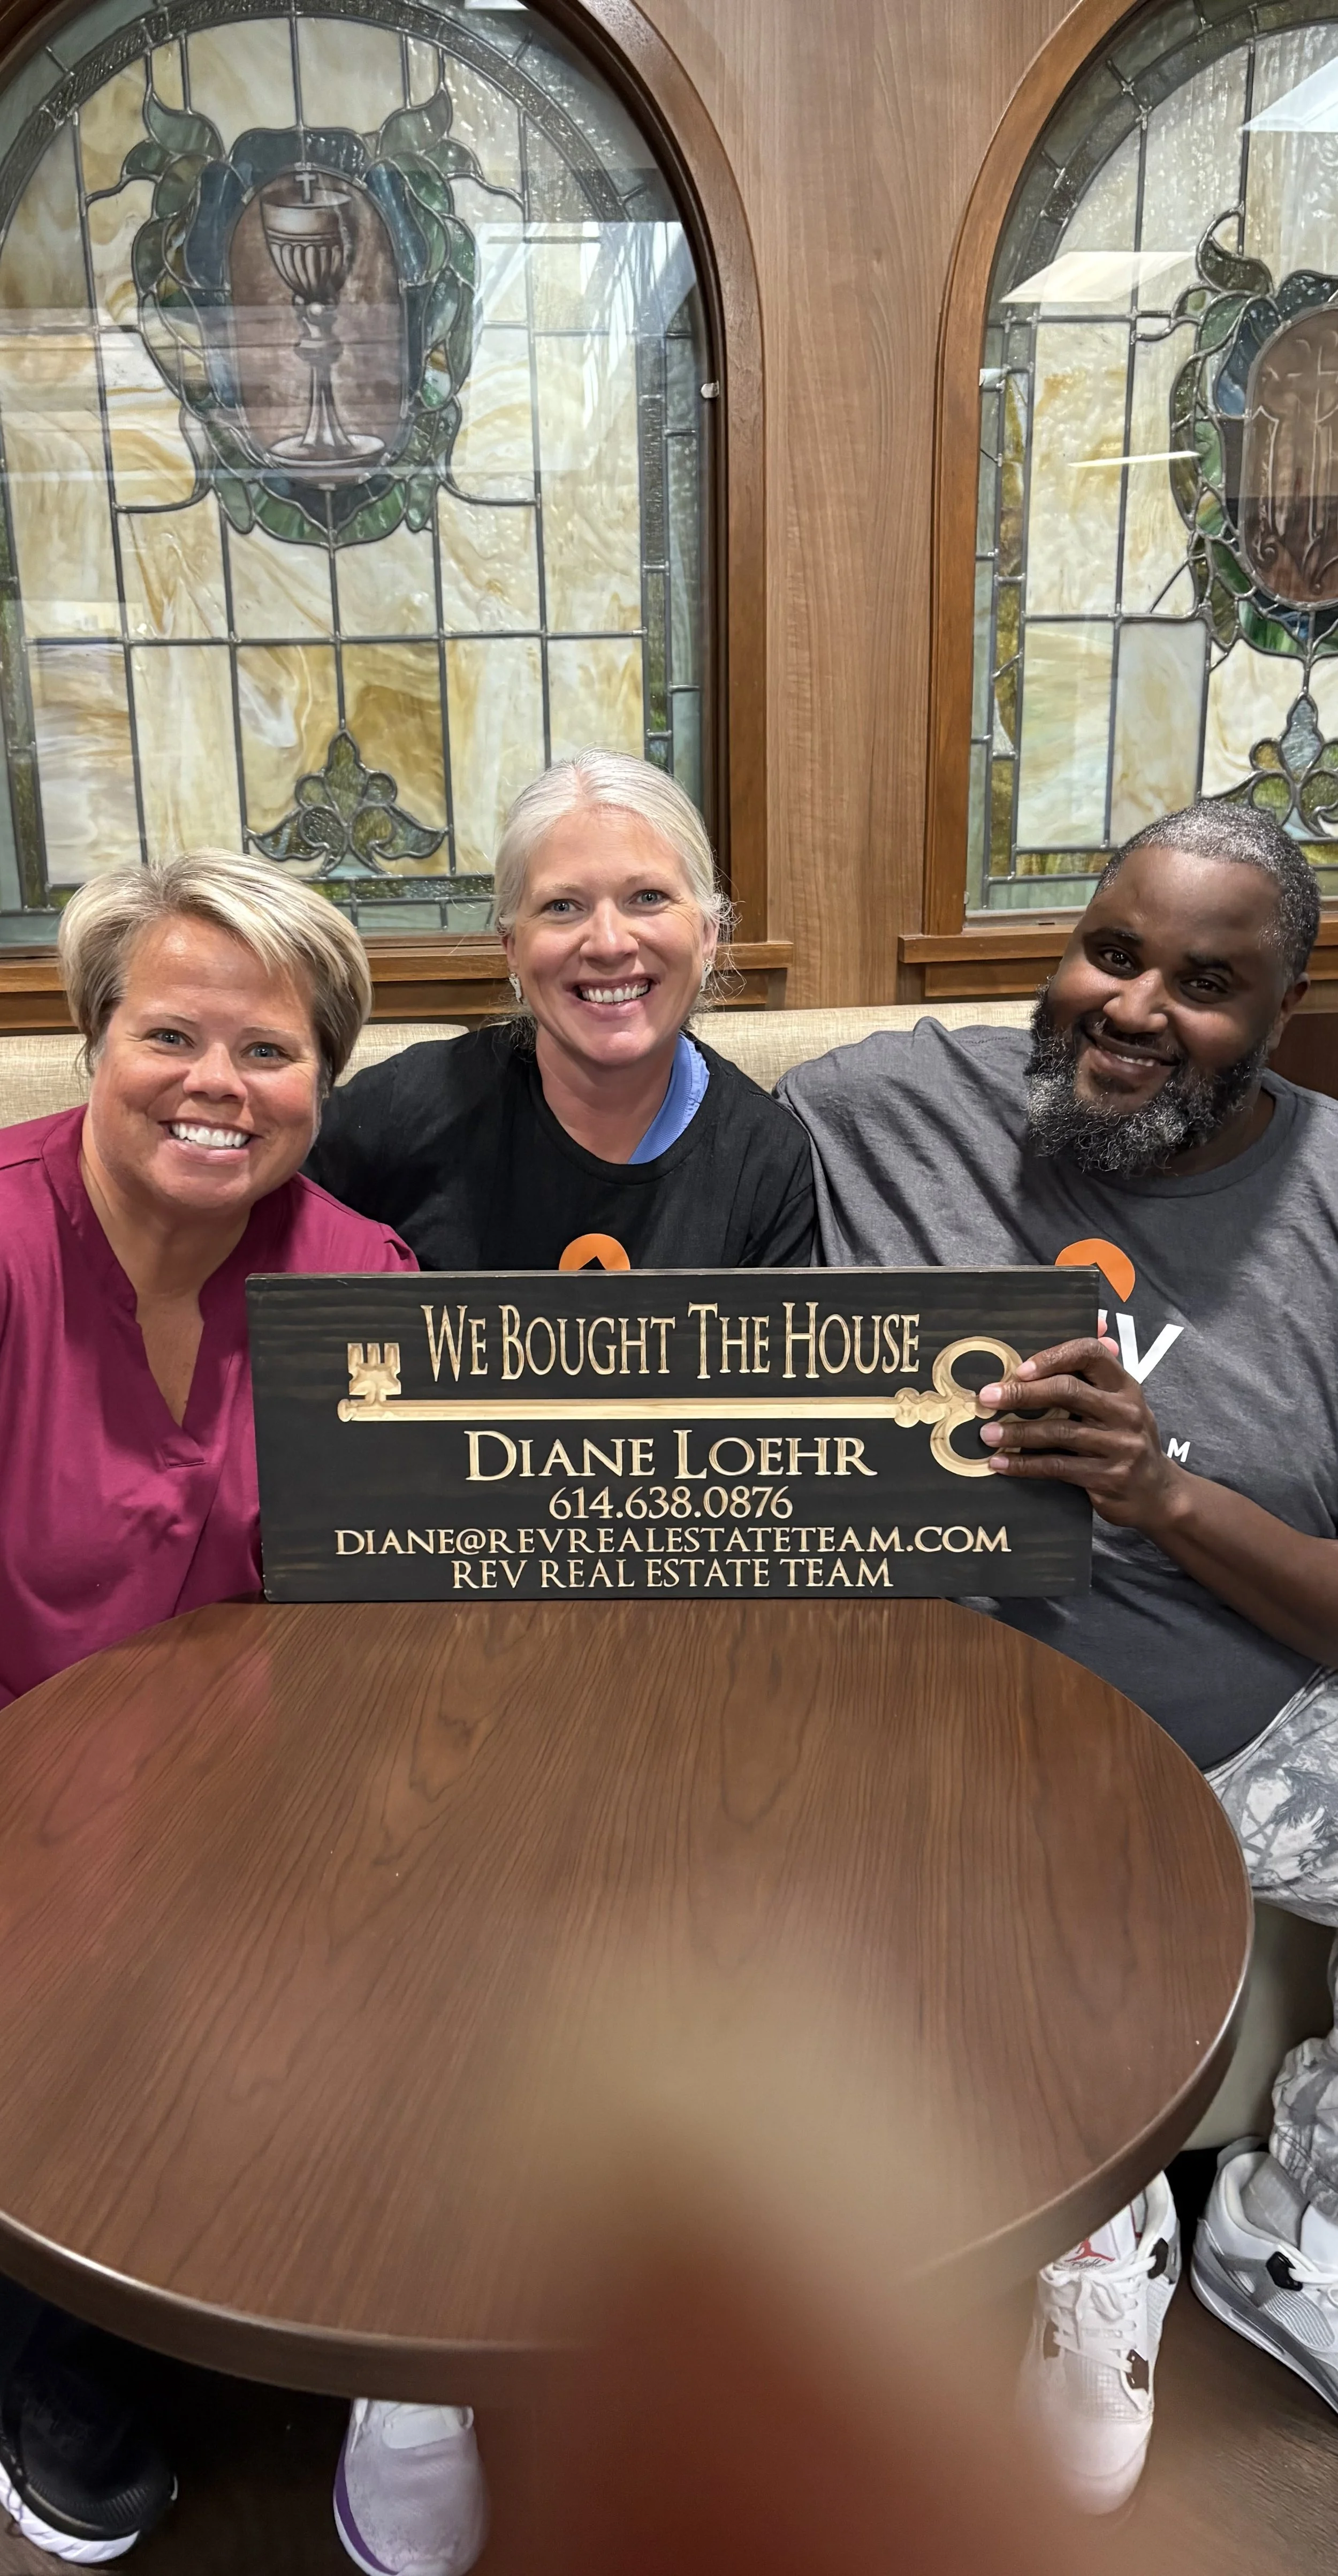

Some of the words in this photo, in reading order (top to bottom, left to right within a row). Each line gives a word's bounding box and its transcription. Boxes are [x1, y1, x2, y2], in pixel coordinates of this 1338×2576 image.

[464, 1431, 655, 1480] DIANE
[673, 1430, 878, 1479] LOEHR
[549, 1486, 793, 1519] 614.638.0876
[334, 1526, 1012, 1555] DIANE@REVREALESTATETEAM.COM
[451, 1560, 528, 1589] REV
[541, 1559, 635, 1588] REAL
[647, 1558, 770, 1587] ESTATE
[780, 1557, 893, 1586] TEAM
